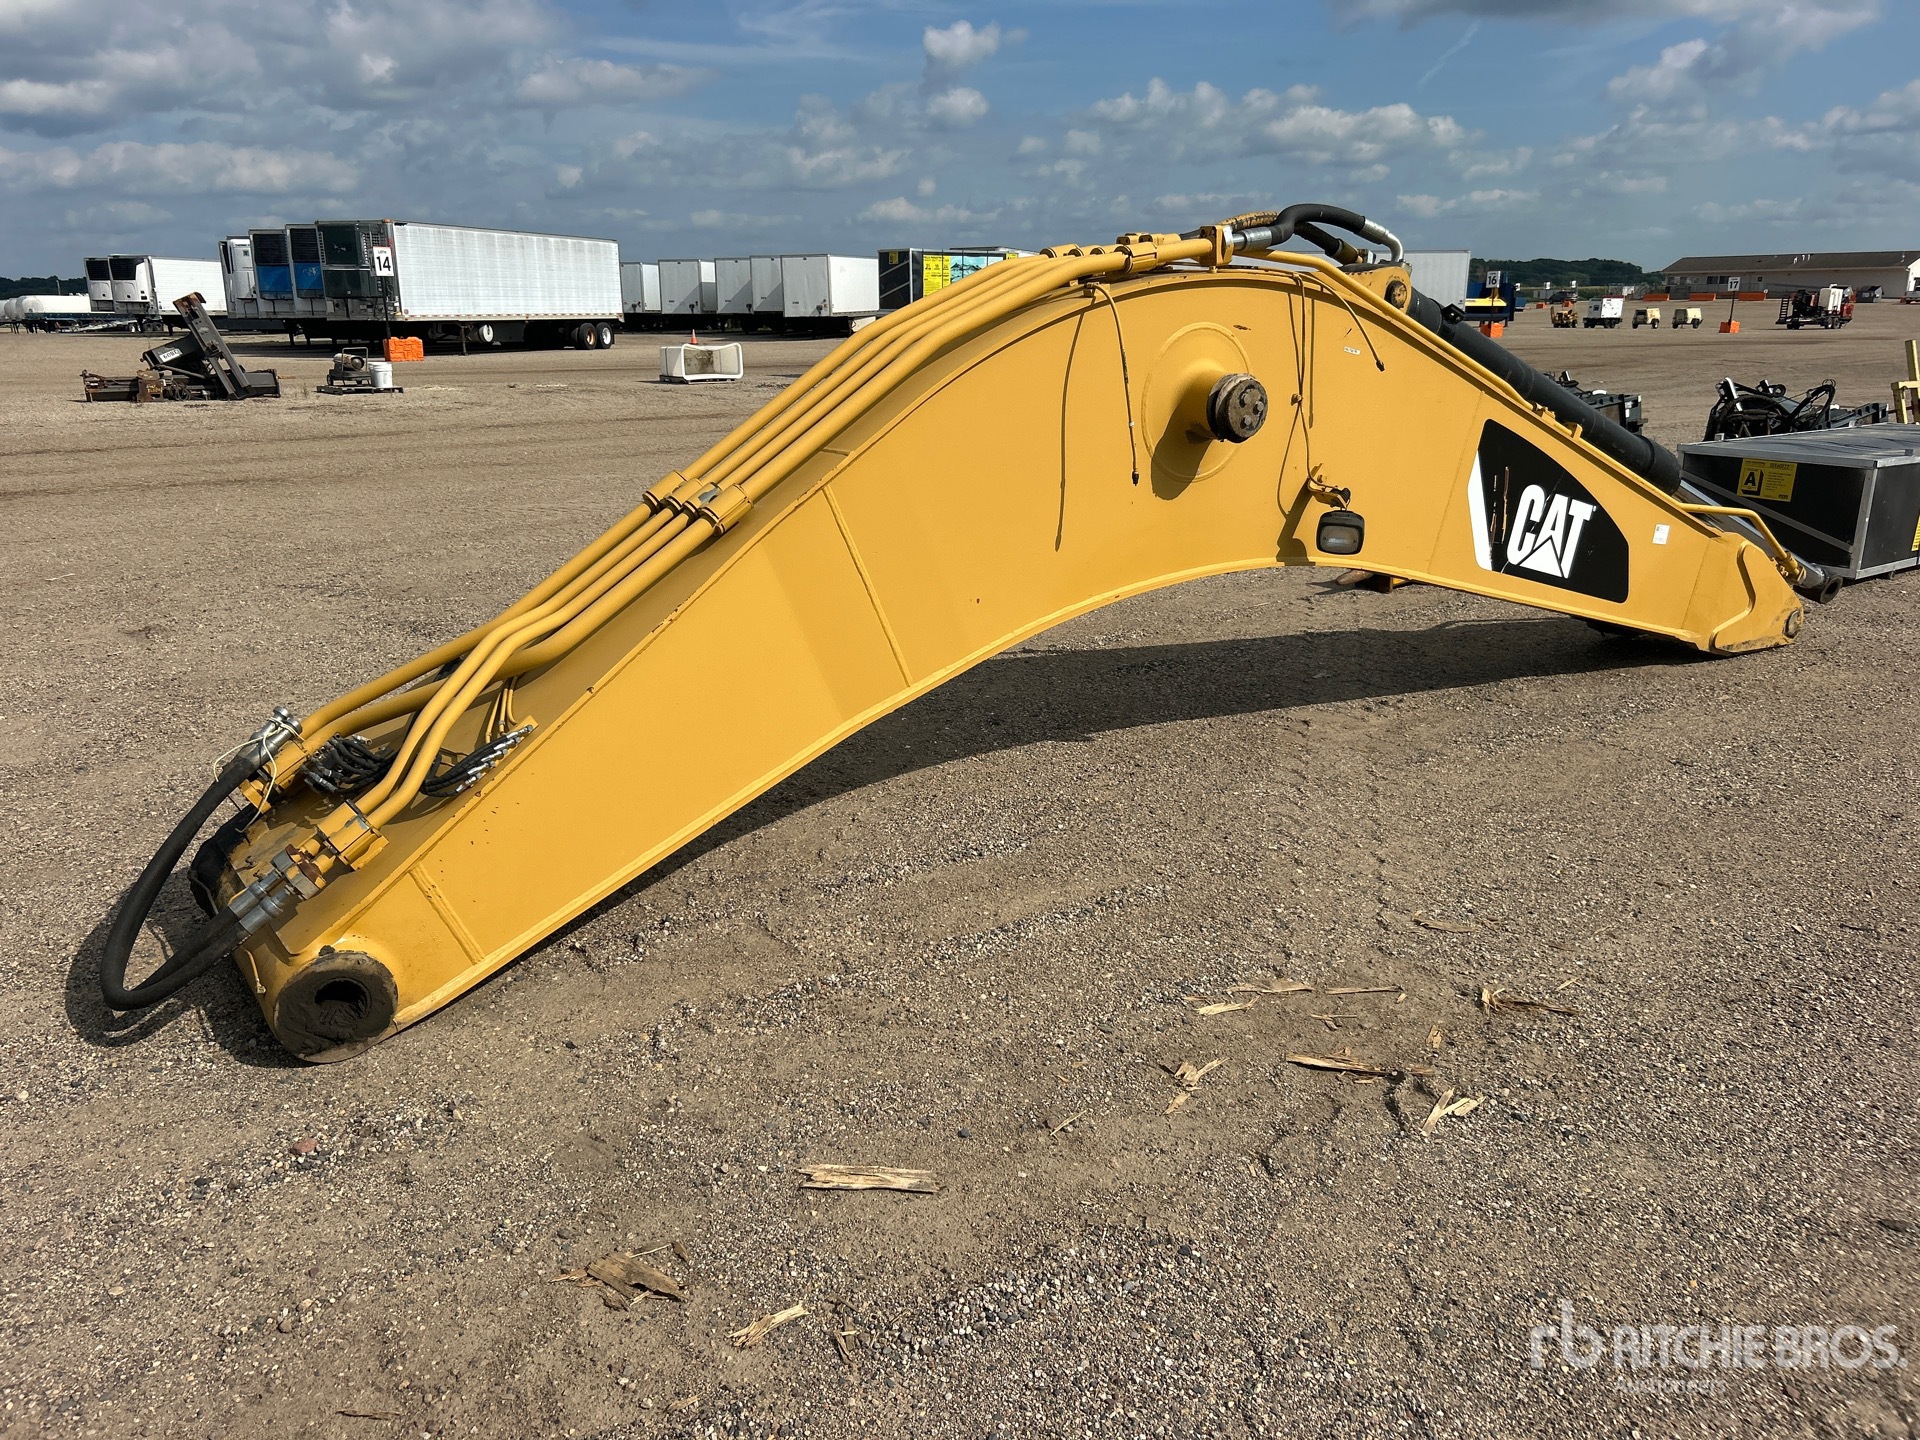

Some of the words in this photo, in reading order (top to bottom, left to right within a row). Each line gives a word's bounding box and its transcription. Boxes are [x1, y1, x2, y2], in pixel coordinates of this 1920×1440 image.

[376, 256, 391, 271] 14
[1487, 275, 1497, 285] 16
[1729, 280, 1739, 289] 17
[1743, 471, 1756, 487] A
[1507, 484, 1593, 579] CAT
